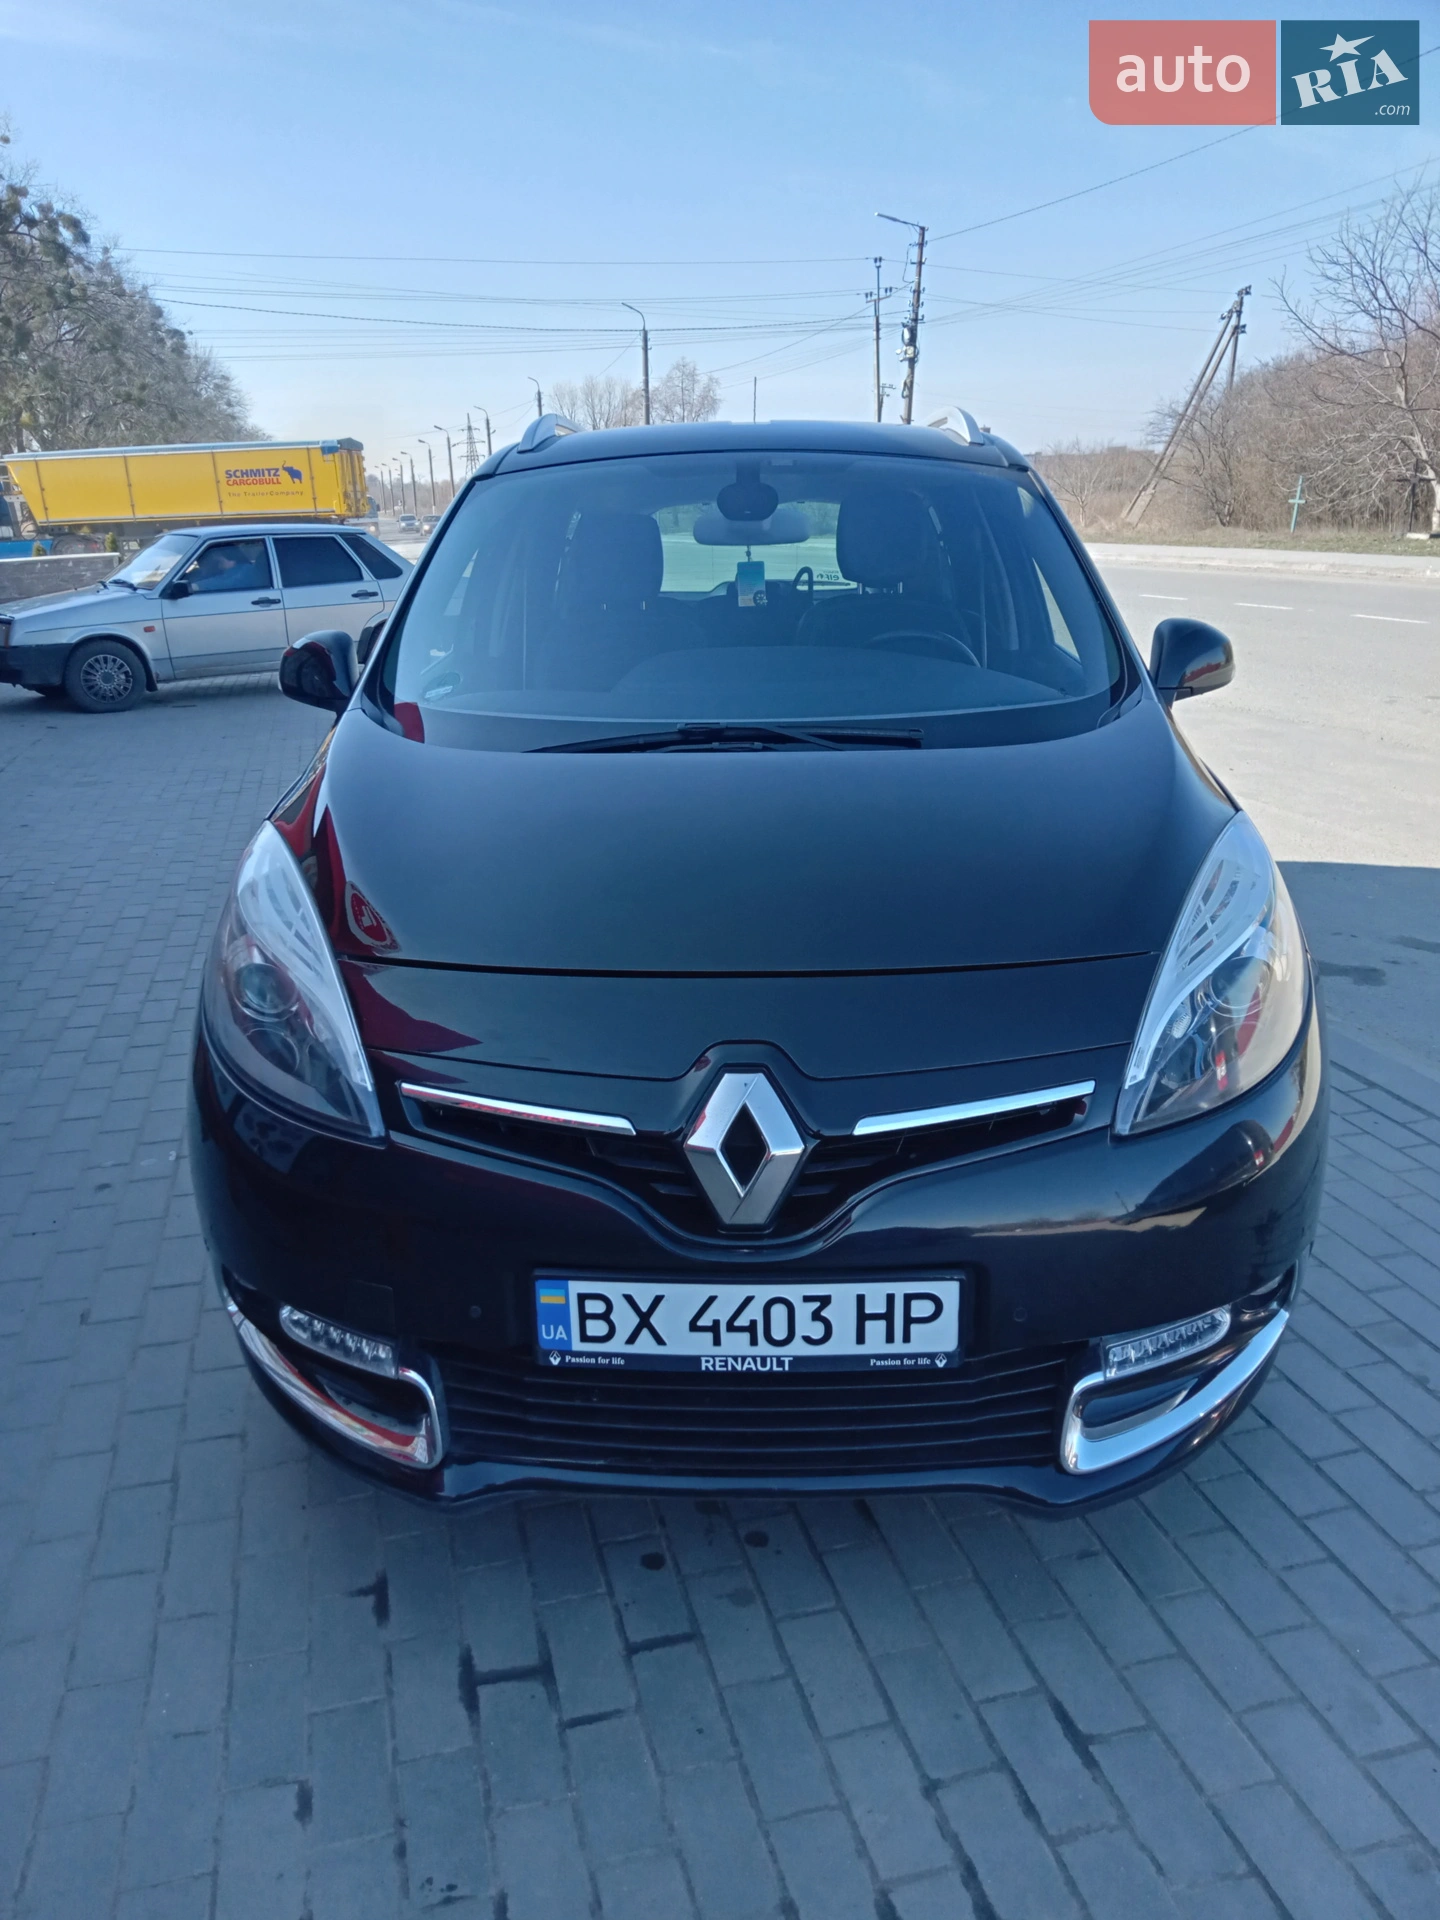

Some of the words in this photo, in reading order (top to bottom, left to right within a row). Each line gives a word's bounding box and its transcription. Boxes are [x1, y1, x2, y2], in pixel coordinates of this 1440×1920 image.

[225, 468, 280, 479] SCHMITZ
[226, 478, 282, 486] CARGOBULL
[577, 1292, 668, 1346] BX
[688, 1295, 833, 1347] 4403
[855, 1292, 944, 1345] HP
[542, 1324, 568, 1340] UA
[565, 1355, 596, 1364] Passion
[597, 1356, 610, 1365] for
[612, 1356, 625, 1365] life
[701, 1356, 794, 1371] RENAULT
[870, 1358, 901, 1366] Passion
[903, 1357, 916, 1366] for
[918, 1356, 931, 1365] life
